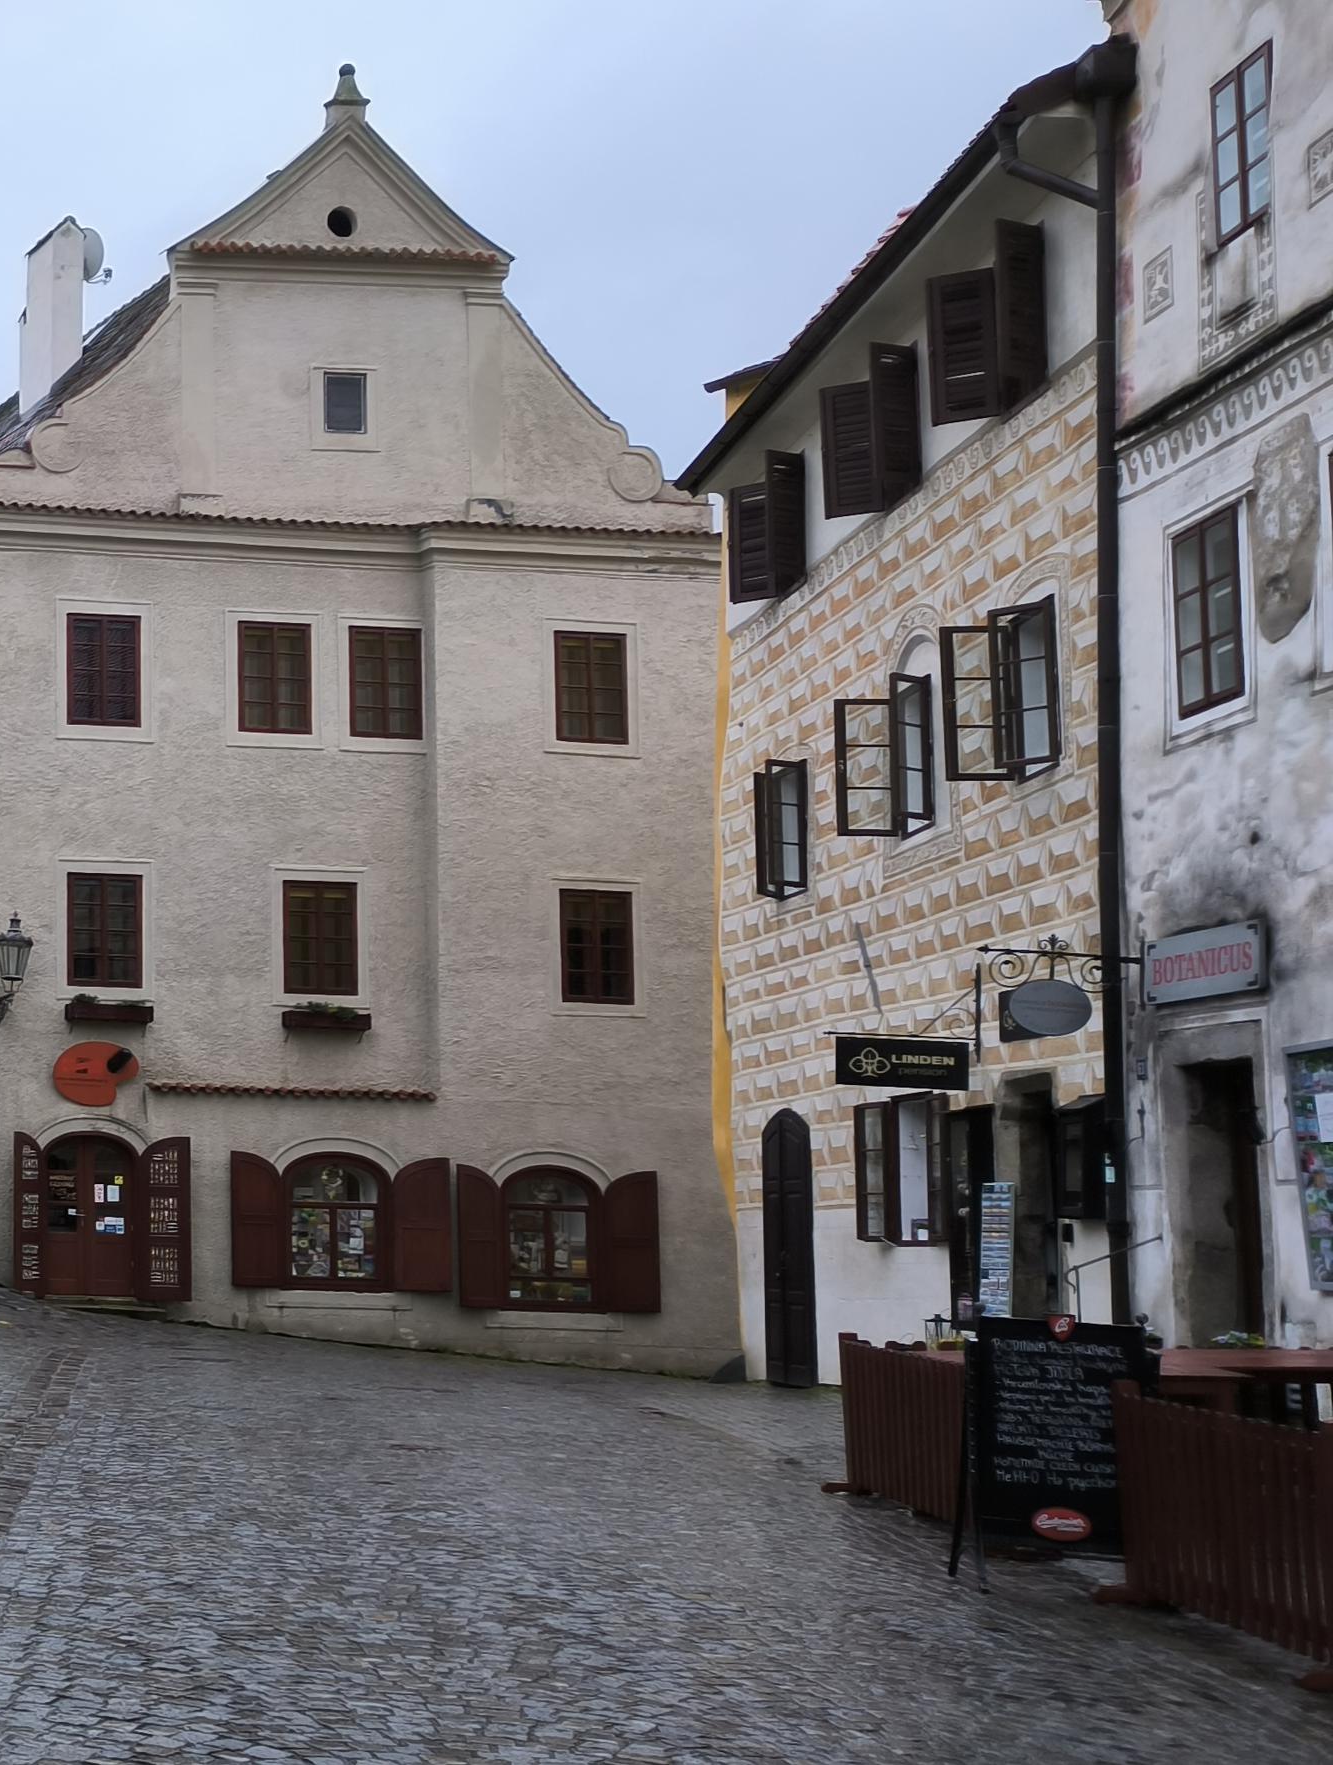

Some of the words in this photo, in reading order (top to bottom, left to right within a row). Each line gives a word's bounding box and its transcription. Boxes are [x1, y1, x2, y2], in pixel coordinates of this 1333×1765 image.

[1152, 941, 1253, 986] BOTANICUS
[891, 1054, 956, 1066] LINDEN
[898, 1067, 947, 1077] pension
